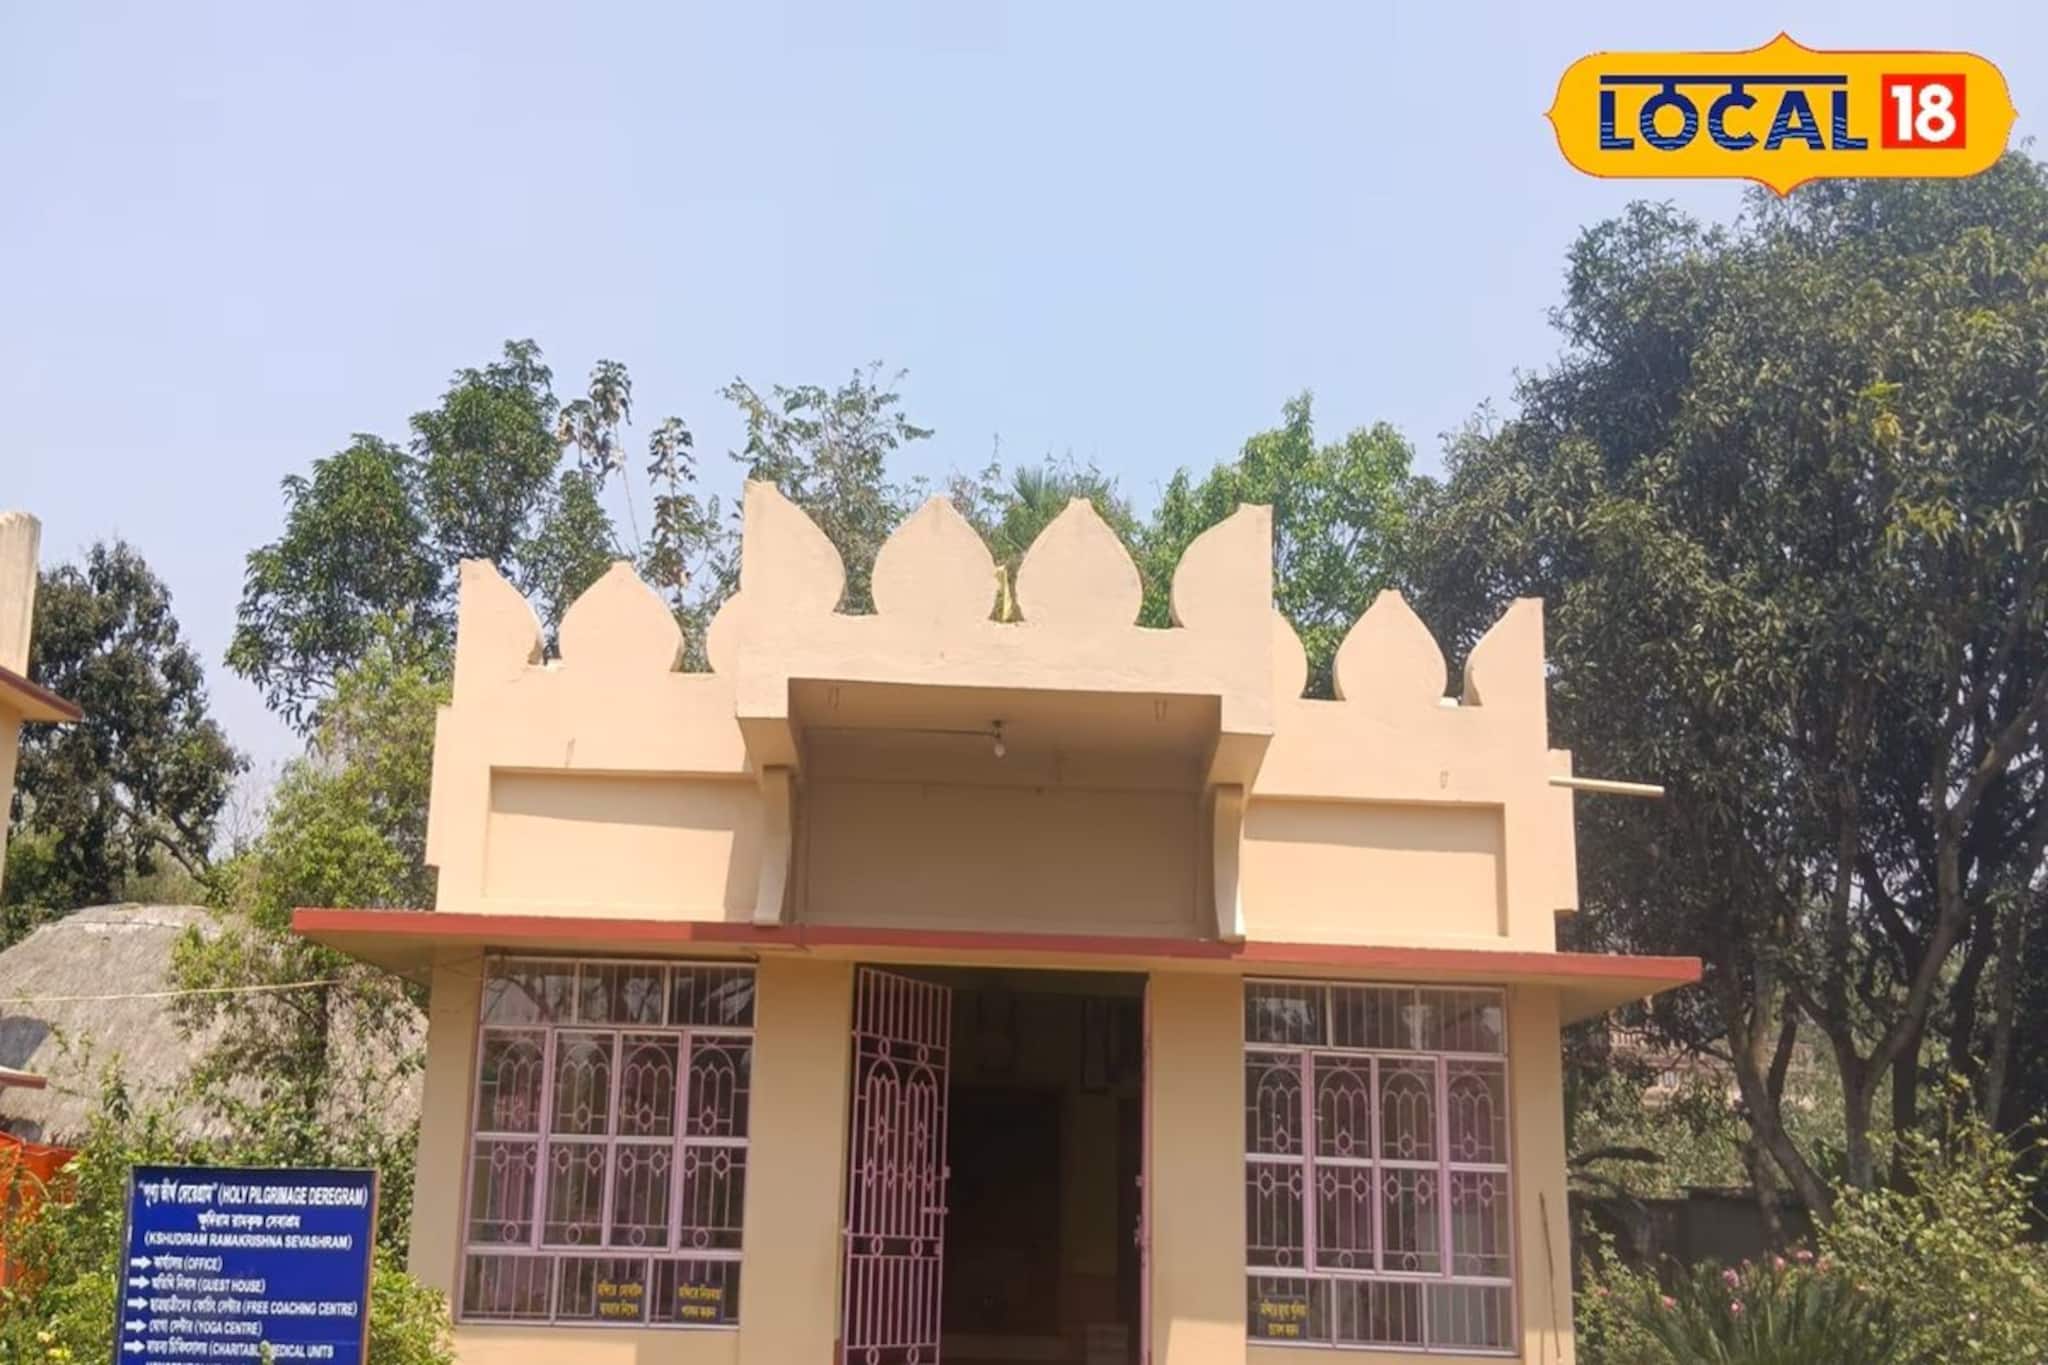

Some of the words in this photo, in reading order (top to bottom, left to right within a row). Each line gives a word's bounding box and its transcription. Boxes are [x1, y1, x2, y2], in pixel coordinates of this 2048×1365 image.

[217, 1182, 249, 1206] (HOLY
[248, 1185, 308, 1205] PILGRIMAGE
[307, 1184, 368, 1209] DEREGRAM)
[144, 1230, 208, 1247] (KSHUDIRAM
[208, 1233, 283, 1248] RAMAKRISHNA
[284, 1233, 352, 1251] SEVASHRAM)
[183, 1255, 223, 1272] (OFFICE)
[198, 1277, 231, 1293] (GUEST
[231, 1278, 266, 1295] HOUSE)
[242, 1299, 270, 1315] (FREE
[270, 1301, 317, 1315] COACHING
[318, 1301, 358, 1317] CENTRE)
[194, 1318, 223, 1335] (YOGA
[223, 1321, 263, 1338] CENTRE)
[209, 1340, 266, 1357] (CHARITABL
